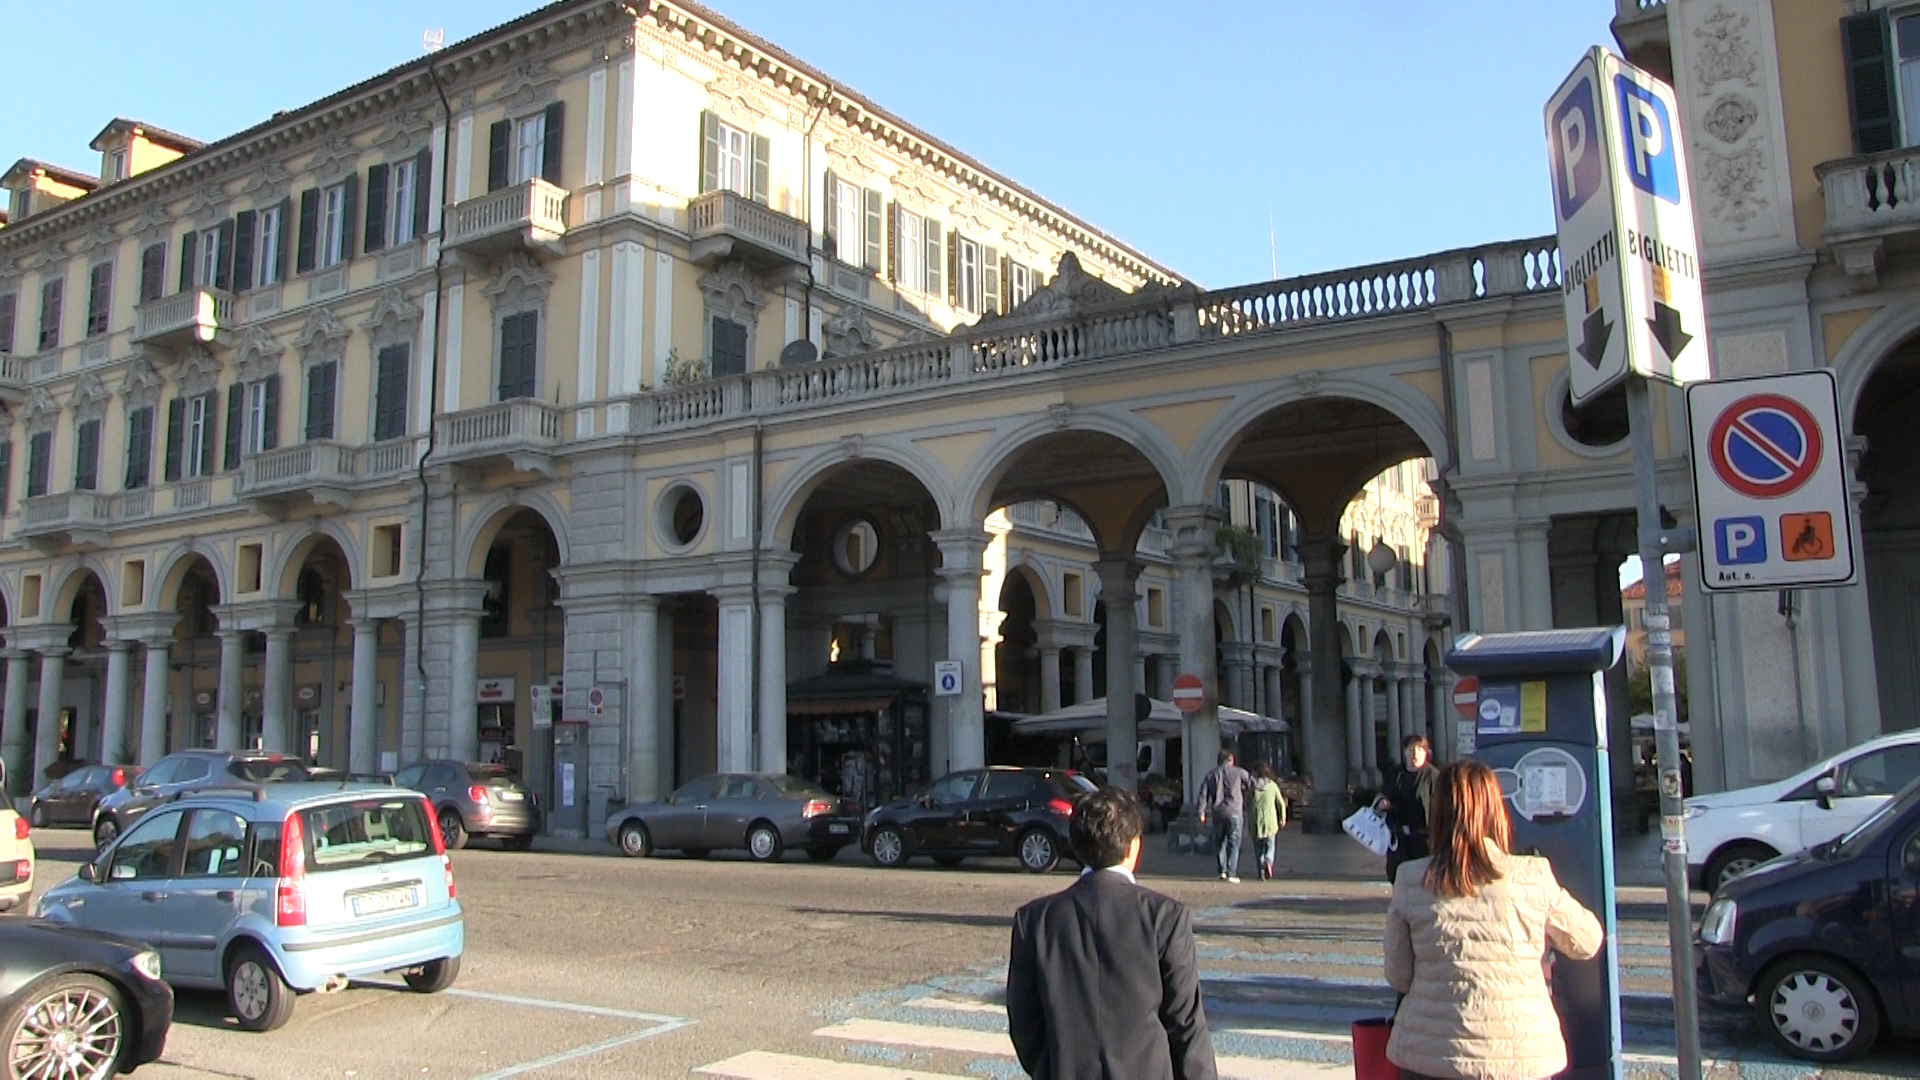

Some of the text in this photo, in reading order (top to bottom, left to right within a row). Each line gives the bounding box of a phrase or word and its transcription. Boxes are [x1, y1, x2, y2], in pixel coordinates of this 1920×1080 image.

[1561, 106, 1586, 200] P
[1628, 92, 1663, 177] P
[1564, 230, 1613, 295] BIGLIETTI
[1628, 228, 1694, 279] BIGLIETTI
[1726, 523, 1756, 560] P
[1719, 571, 1741, 582] Aut.
